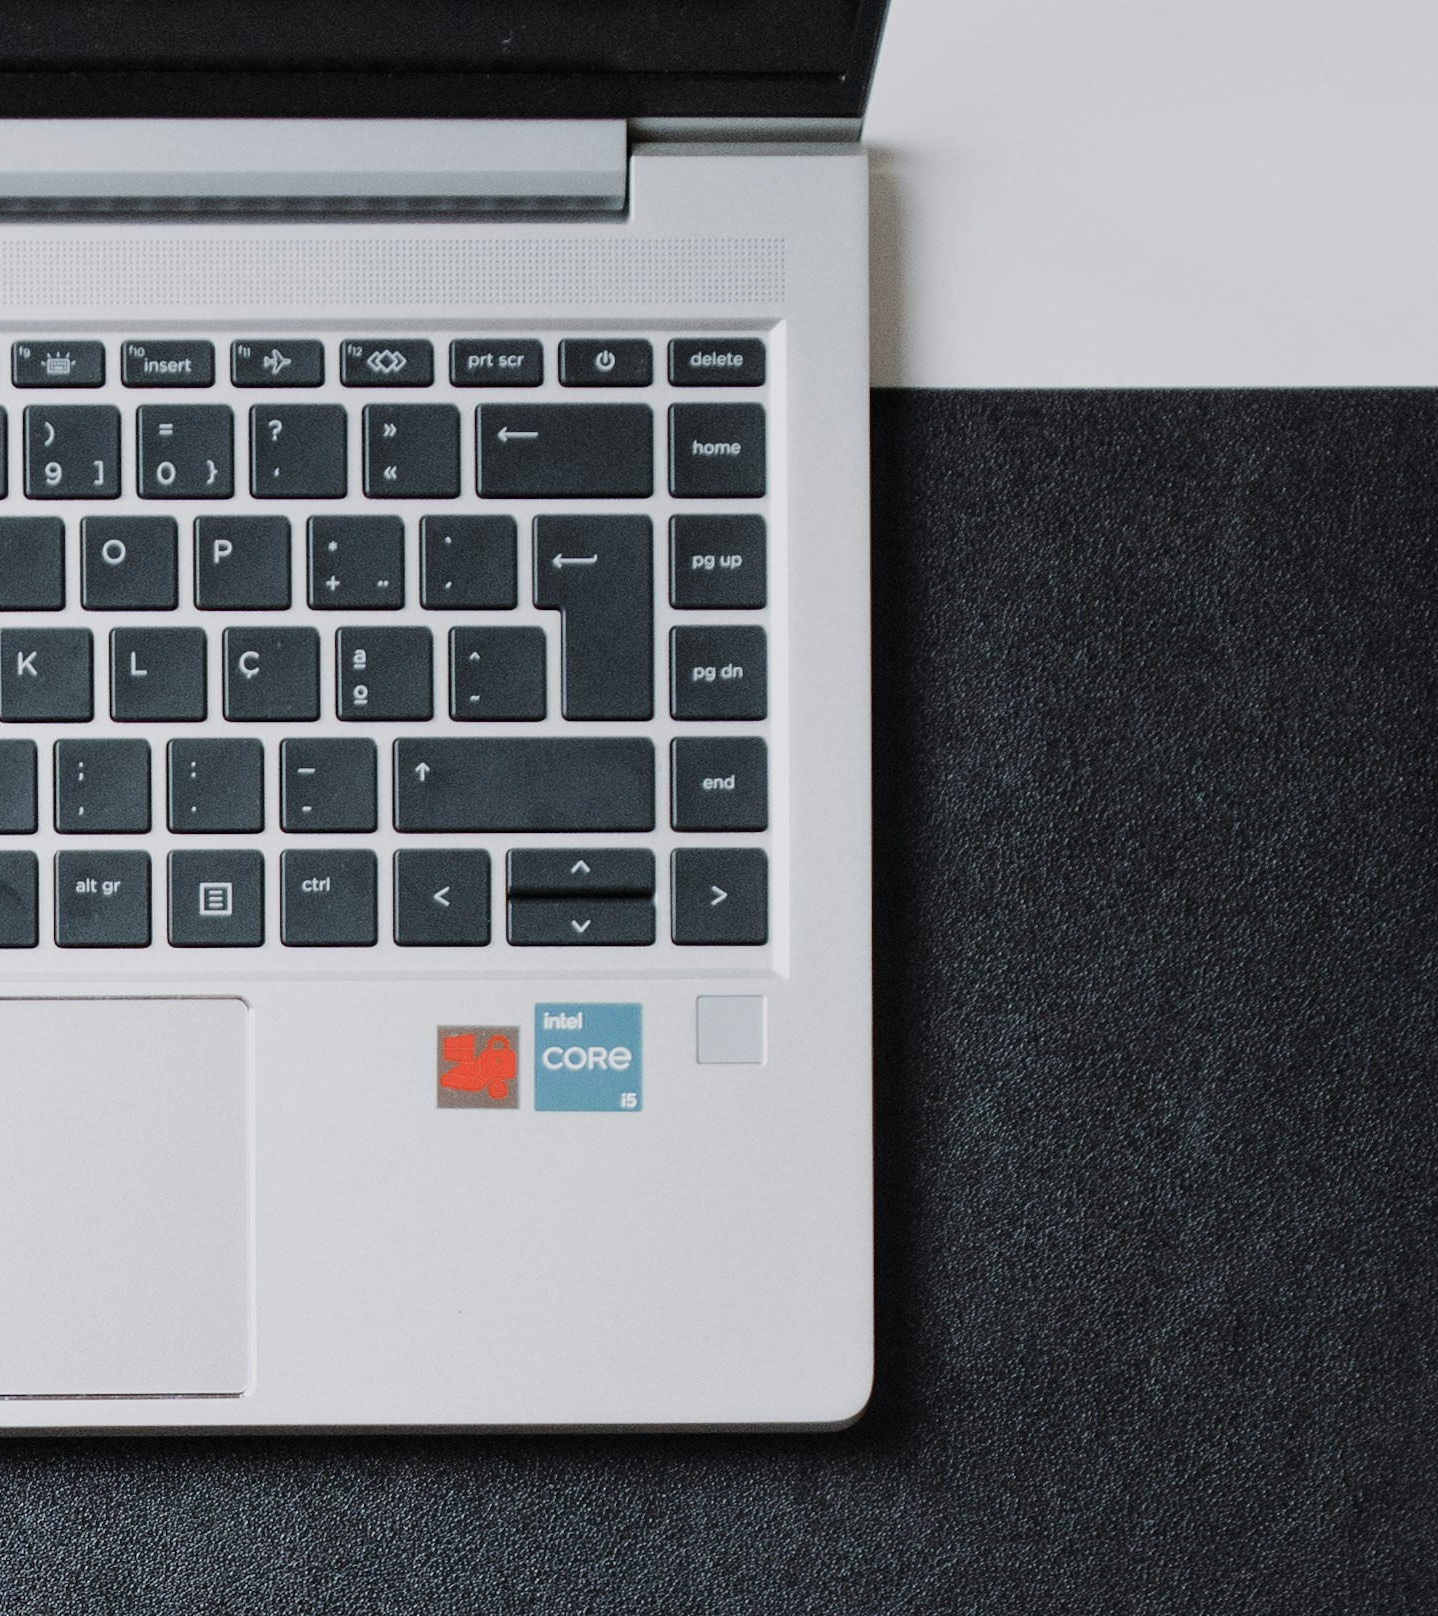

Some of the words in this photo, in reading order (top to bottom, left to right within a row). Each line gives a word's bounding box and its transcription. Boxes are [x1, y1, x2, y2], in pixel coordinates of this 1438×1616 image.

[18, 346, 31, 359] f9
[128, 345, 145, 357] f10
[238, 345, 251, 357] f11
[347, 344, 363, 357] f12
[690, 352, 743, 366] delete
[143, 355, 193, 374] insert
[468, 353, 494, 369] prt
[498, 355, 524, 368] scr
[44, 421, 55, 447] )
[158, 423, 174, 436] =
[268, 419, 283, 441] ?
[692, 440, 741, 456] home
[45, 462, 62, 486] 9
[94, 460, 104, 486] ]
[206, 459, 218, 485] }
[101, 539, 126, 565] O
[213, 539, 233, 564] P
[692, 555, 715, 570] pg
[719, 554, 743, 569] up
[325, 575, 340, 591] +
[17, 651, 38, 676] K
[130, 651, 148, 677] L
[238, 650, 260, 679] Ç
[693, 666, 716, 682] pg
[720, 663, 743, 679] dn
[702, 774, 735, 790] end
[75, 878, 97, 893] alt
[101, 880, 121, 896] gr
[301, 876, 331, 892] ctrl
[543, 1011, 583, 1030] intel
[620, 1092, 638, 1109] i5
